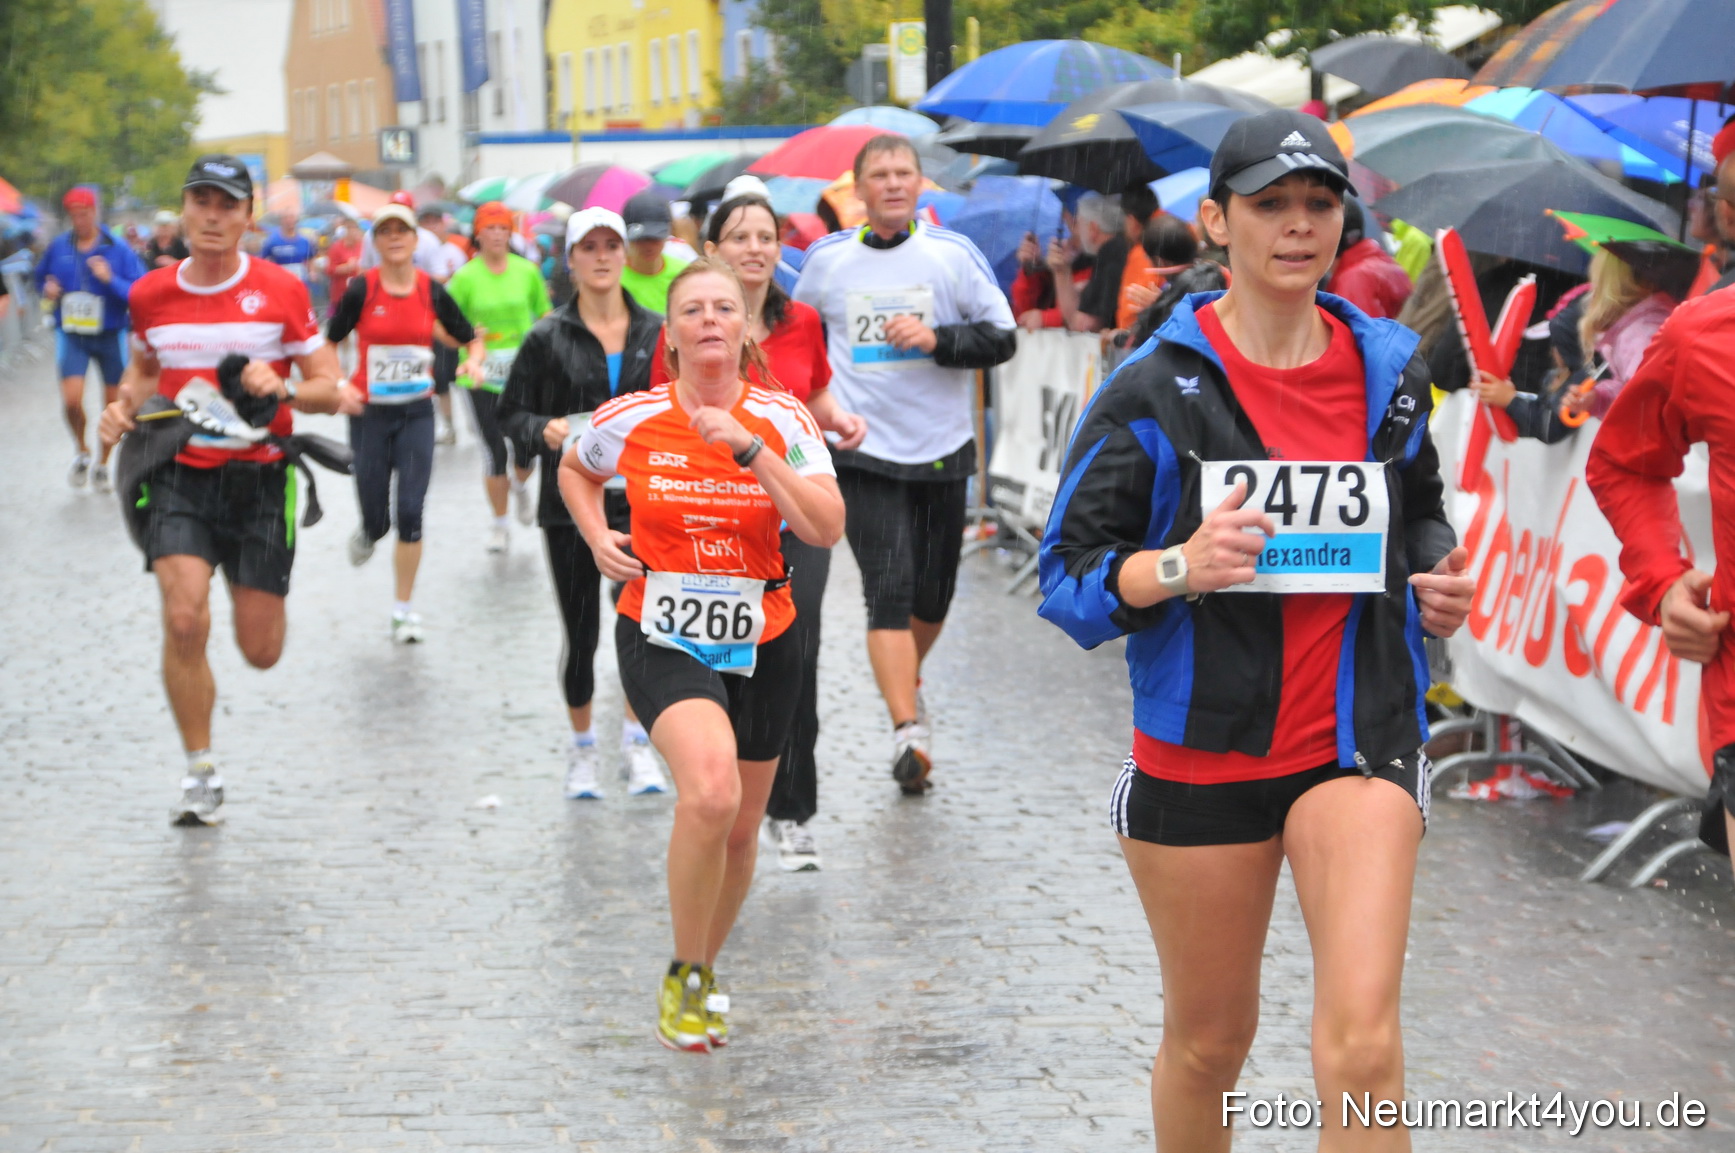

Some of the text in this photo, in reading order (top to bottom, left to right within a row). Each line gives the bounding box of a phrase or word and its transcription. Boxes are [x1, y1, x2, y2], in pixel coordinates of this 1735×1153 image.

[1224, 464, 1370, 527] 2473
[700, 537, 738, 557] GfK
[1257, 542, 1352, 567] lexandra
[655, 595, 753, 641] 3266
